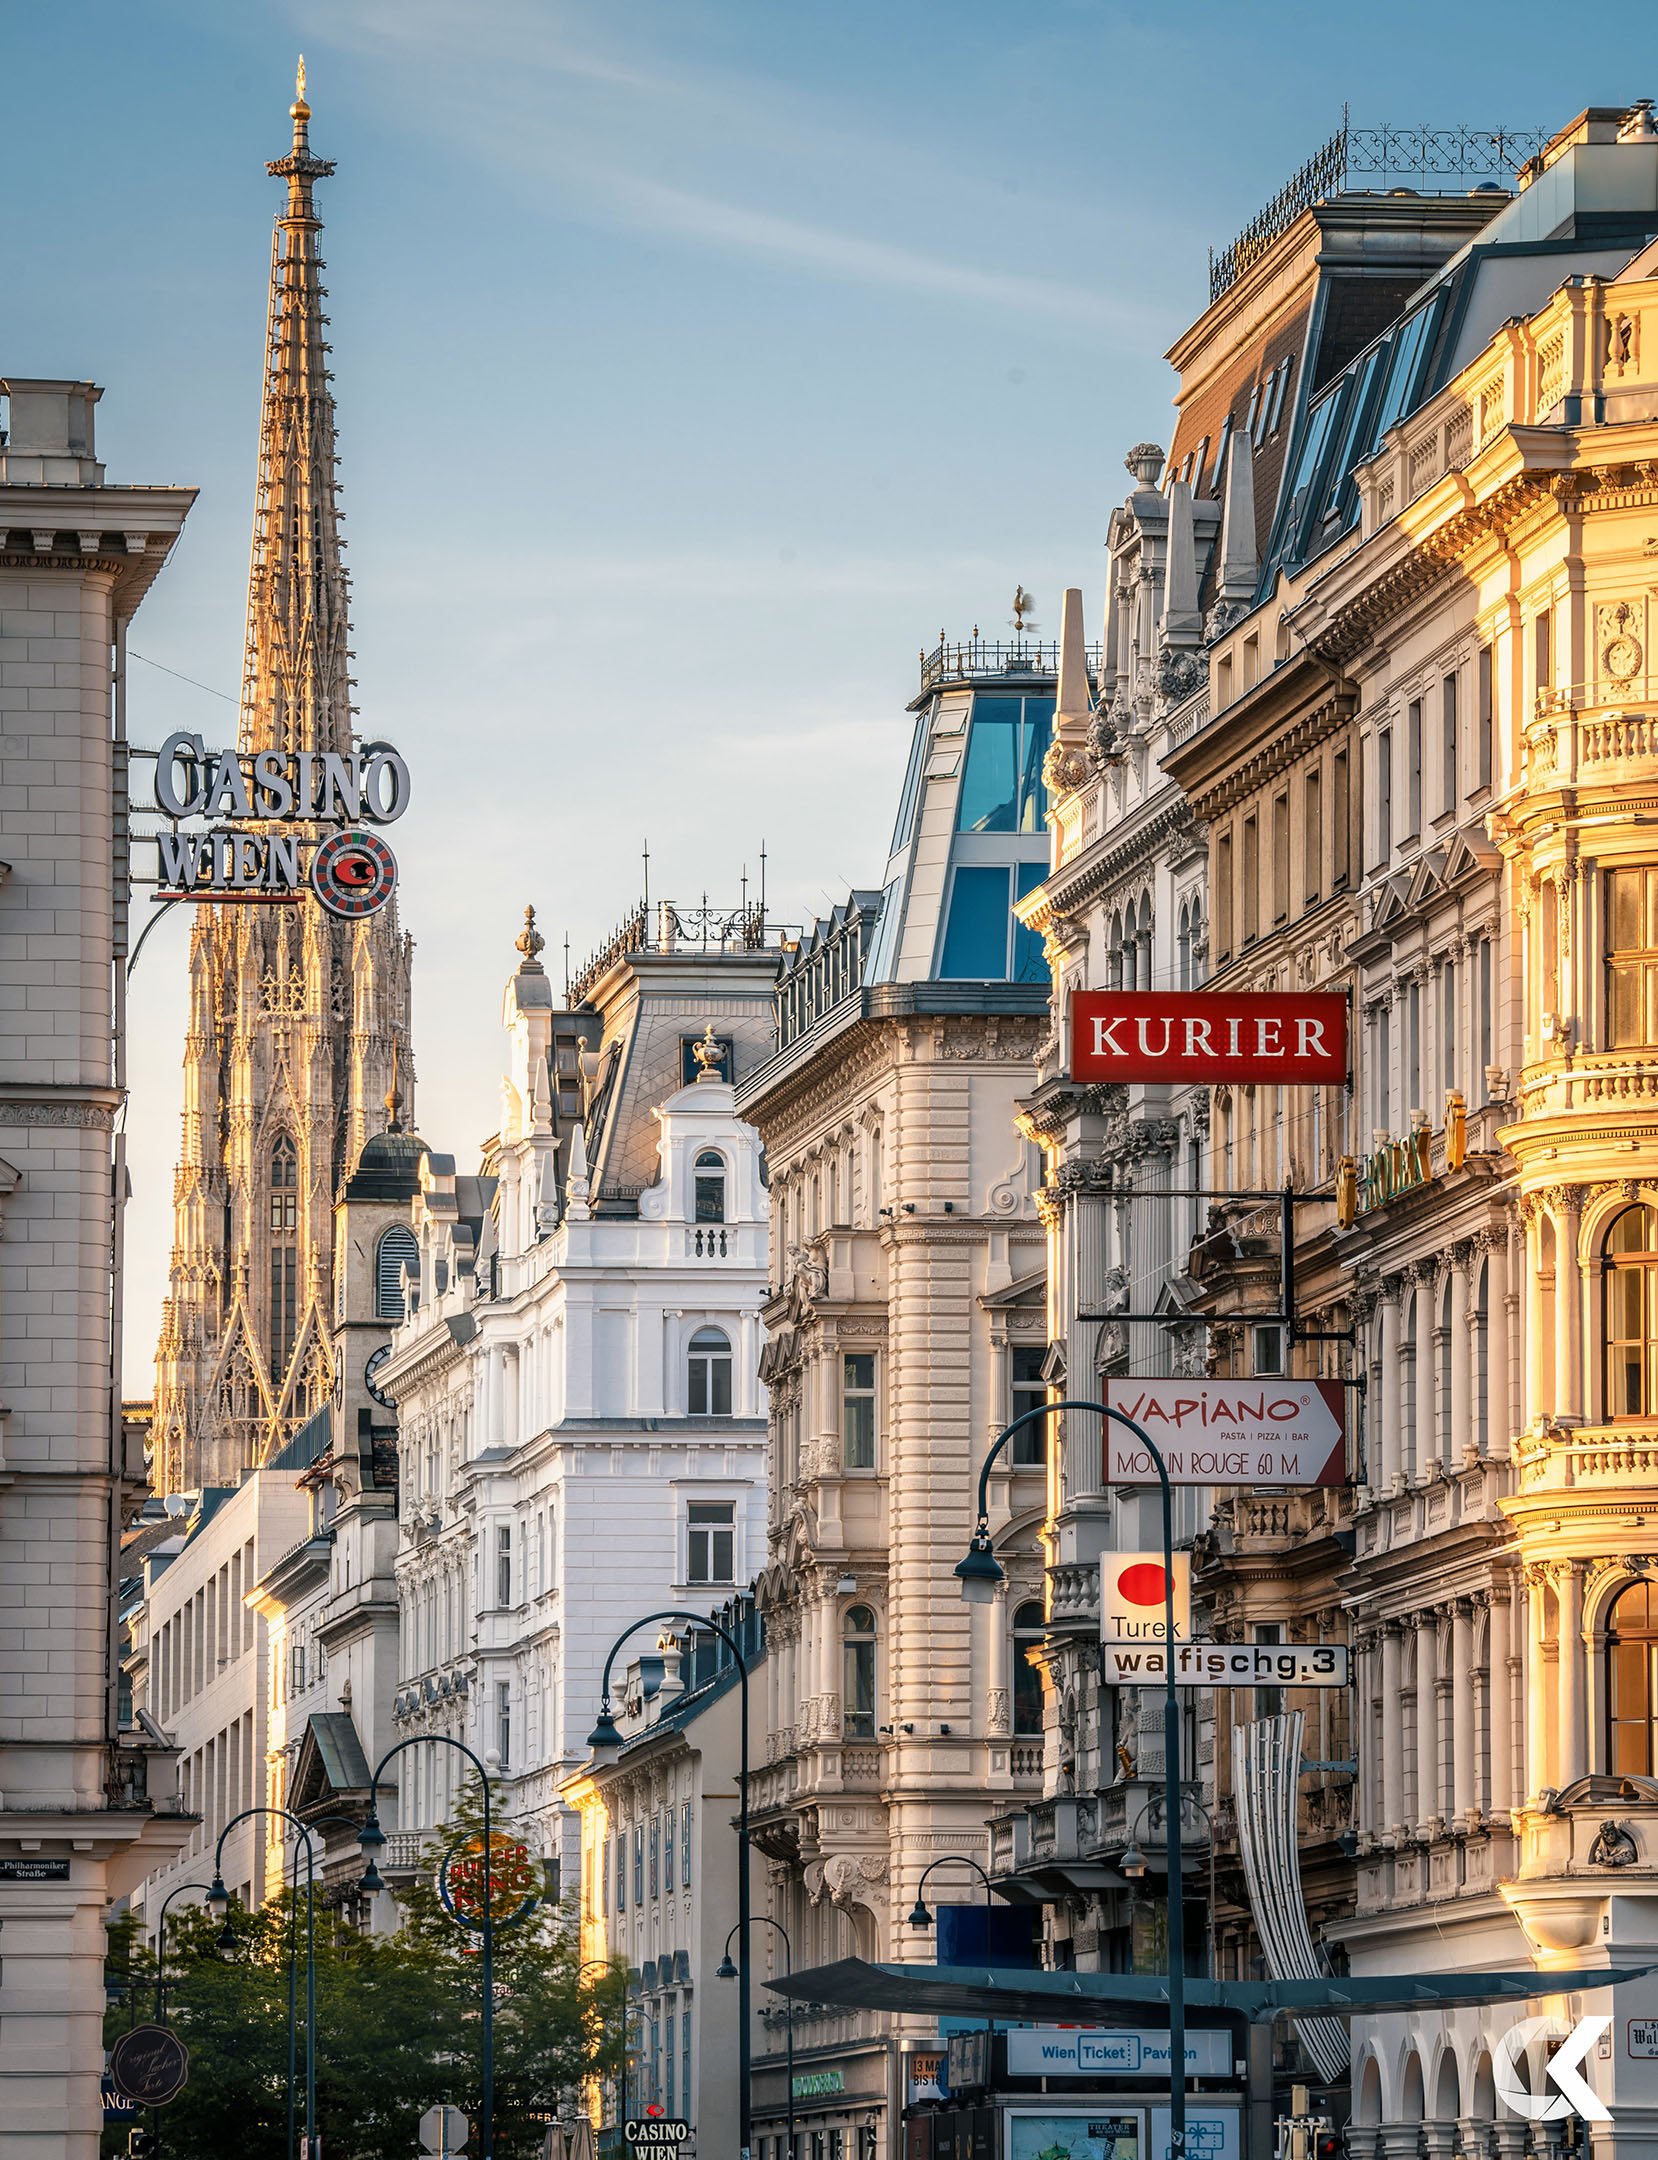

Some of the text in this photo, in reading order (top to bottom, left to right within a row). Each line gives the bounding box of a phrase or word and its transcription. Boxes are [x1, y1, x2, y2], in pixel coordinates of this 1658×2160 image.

[155, 731, 410, 825] CASINO
[157, 831, 301, 889] WIEN
[1090, 1017, 1332, 1058] KURIER
[1220, 1432, 1310, 1442] PASTA PIZZA BAR
[1191, 1452, 1249, 1475] ROUGE
[1257, 1453, 1273, 1475] 60
[1281, 1453, 1301, 1476] M.
[1113, 1647, 1335, 1680] wafischg.3
[16, 1869, 47, 1878] Straße
[1042, 2046, 1076, 2059] Wien
[1083, 2045, 1125, 2059] Ticket
[913, 2060, 923, 2072] 13
[913, 2074, 929, 2086] BIS
[624, 2121, 687, 2141] CASINO
[634, 2145, 678, 2160] WIEN
